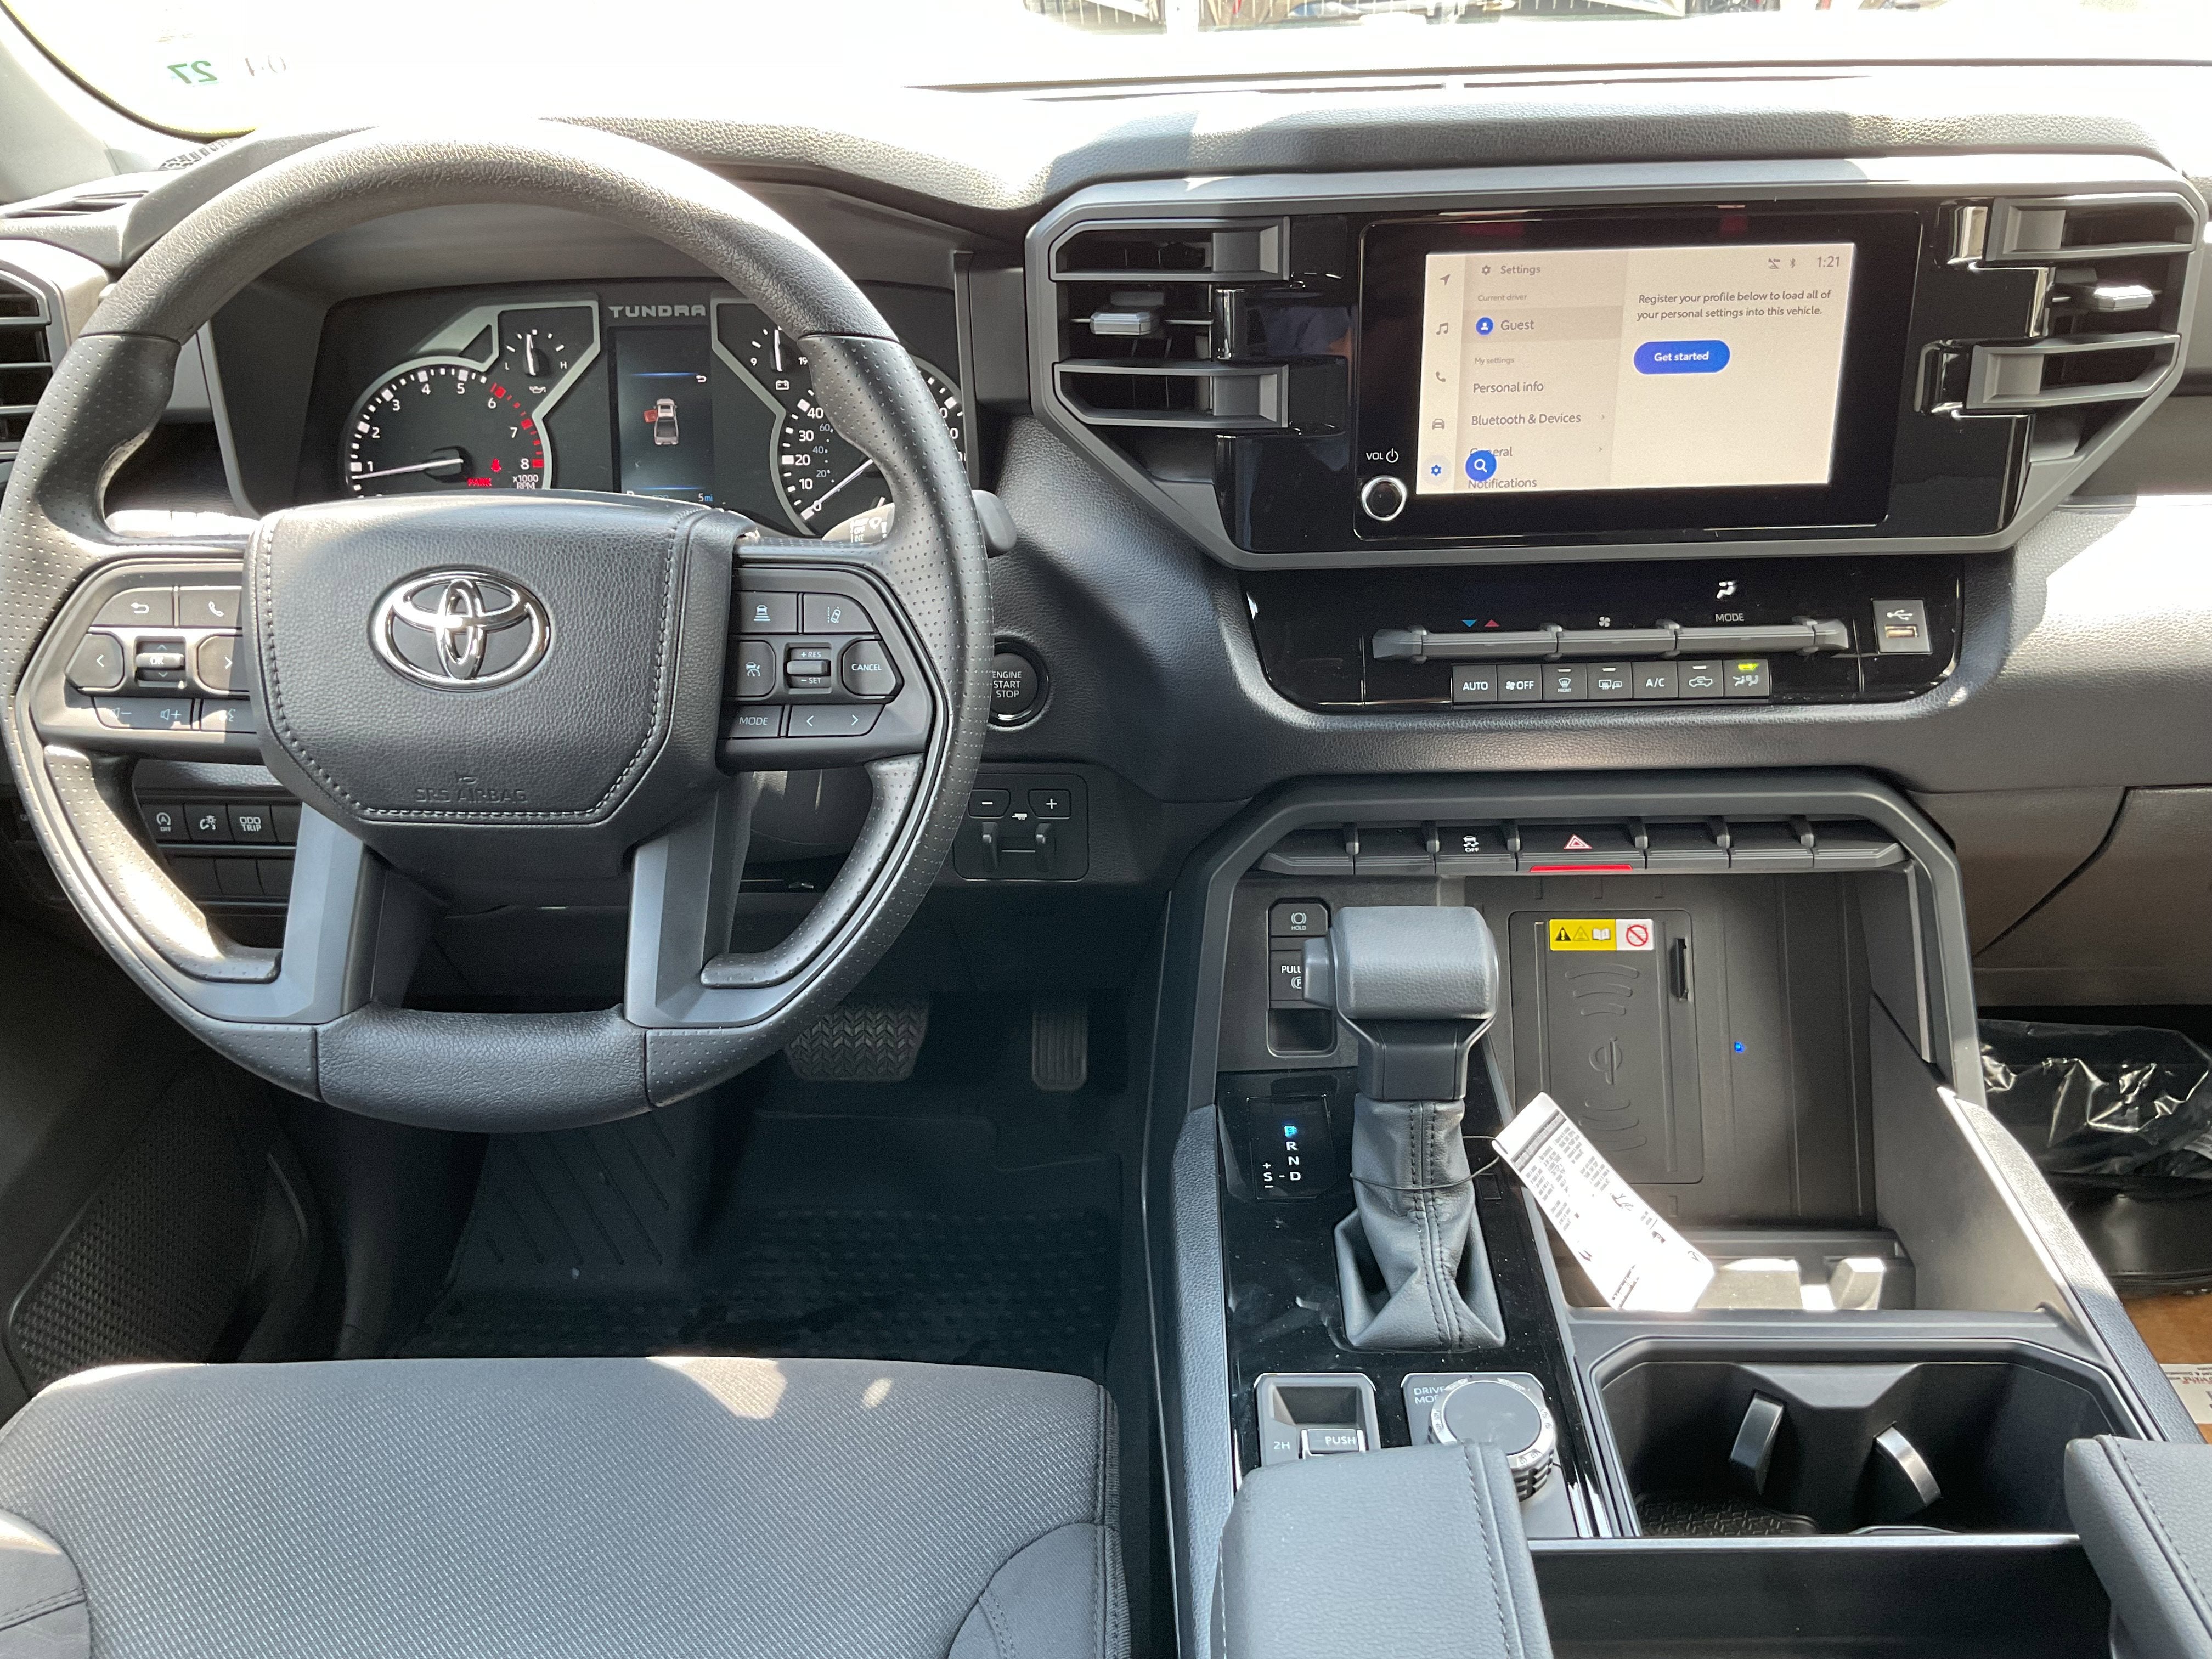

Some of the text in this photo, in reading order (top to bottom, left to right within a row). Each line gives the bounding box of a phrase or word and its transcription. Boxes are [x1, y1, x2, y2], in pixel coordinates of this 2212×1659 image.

[1817, 256, 1839, 268] 1:21
[1500, 265, 1541, 275] Settings
[1639, 294, 1678, 305] Register
[1679, 295, 1701, 304] your
[1703, 292, 1735, 303] profile
[1737, 291, 1767, 301] below
[1782, 291, 1804, 300] load
[1806, 290, 1818, 299] all
[1820, 290, 1831, 299] of
[608, 304, 706, 318] TUNDRA
[1637, 306, 1822, 321] your personal settings into this vehicle.
[1500, 320, 1534, 330] Guest
[798, 357, 808, 365] 19
[1486, 356, 1514, 365] settings
[1654, 351, 1709, 362] Get started
[505, 362, 510, 370] L
[560, 361, 567, 369] H
[751, 358, 757, 366] 9
[421, 384, 431, 395] 4
[457, 383, 465, 394] 5
[1473, 381, 1544, 393] Personal info
[393, 400, 400, 411] 3
[488, 398, 496, 409] 6
[807, 407, 824, 419] 40
[1471, 413, 1581, 426] Bluetooth & Devices
[372, 427, 380, 438] 2
[511, 427, 517, 438] 7
[819, 424, 831, 432] 60
[799, 430, 815, 442] 30
[795, 454, 811, 465] 20
[1366, 452, 1384, 460] VOL
[367, 461, 373, 471] 1
[521, 458, 529, 470] 8
[512, 474, 539, 483] x1000
[816, 470, 827, 478] 20
[799, 478, 813, 489] 10
[1468, 478, 1537, 489] Notifications
[698, 493, 704, 502] 5
[1715, 612, 1745, 623] MODE
[993, 680, 1020, 689] START
[1463, 681, 1488, 690] AUTO
[1516, 681, 1534, 690] OFF
[1646, 677, 1664, 688] A/C
[996, 690, 1019, 698] STOP
[739, 716, 769, 725] MODE
[1281, 965, 1301, 973] PULL
[1284, 1125, 1297, 1137] P
[1286, 1141, 1298, 1150] R
[1288, 1156, 1300, 1165] N
[1263, 1172, 1273, 1181] S
[1290, 1171, 1301, 1181] D
[1273, 1441, 1290, 1450] 2H
[1325, 1436, 1356, 1446] PUSH
